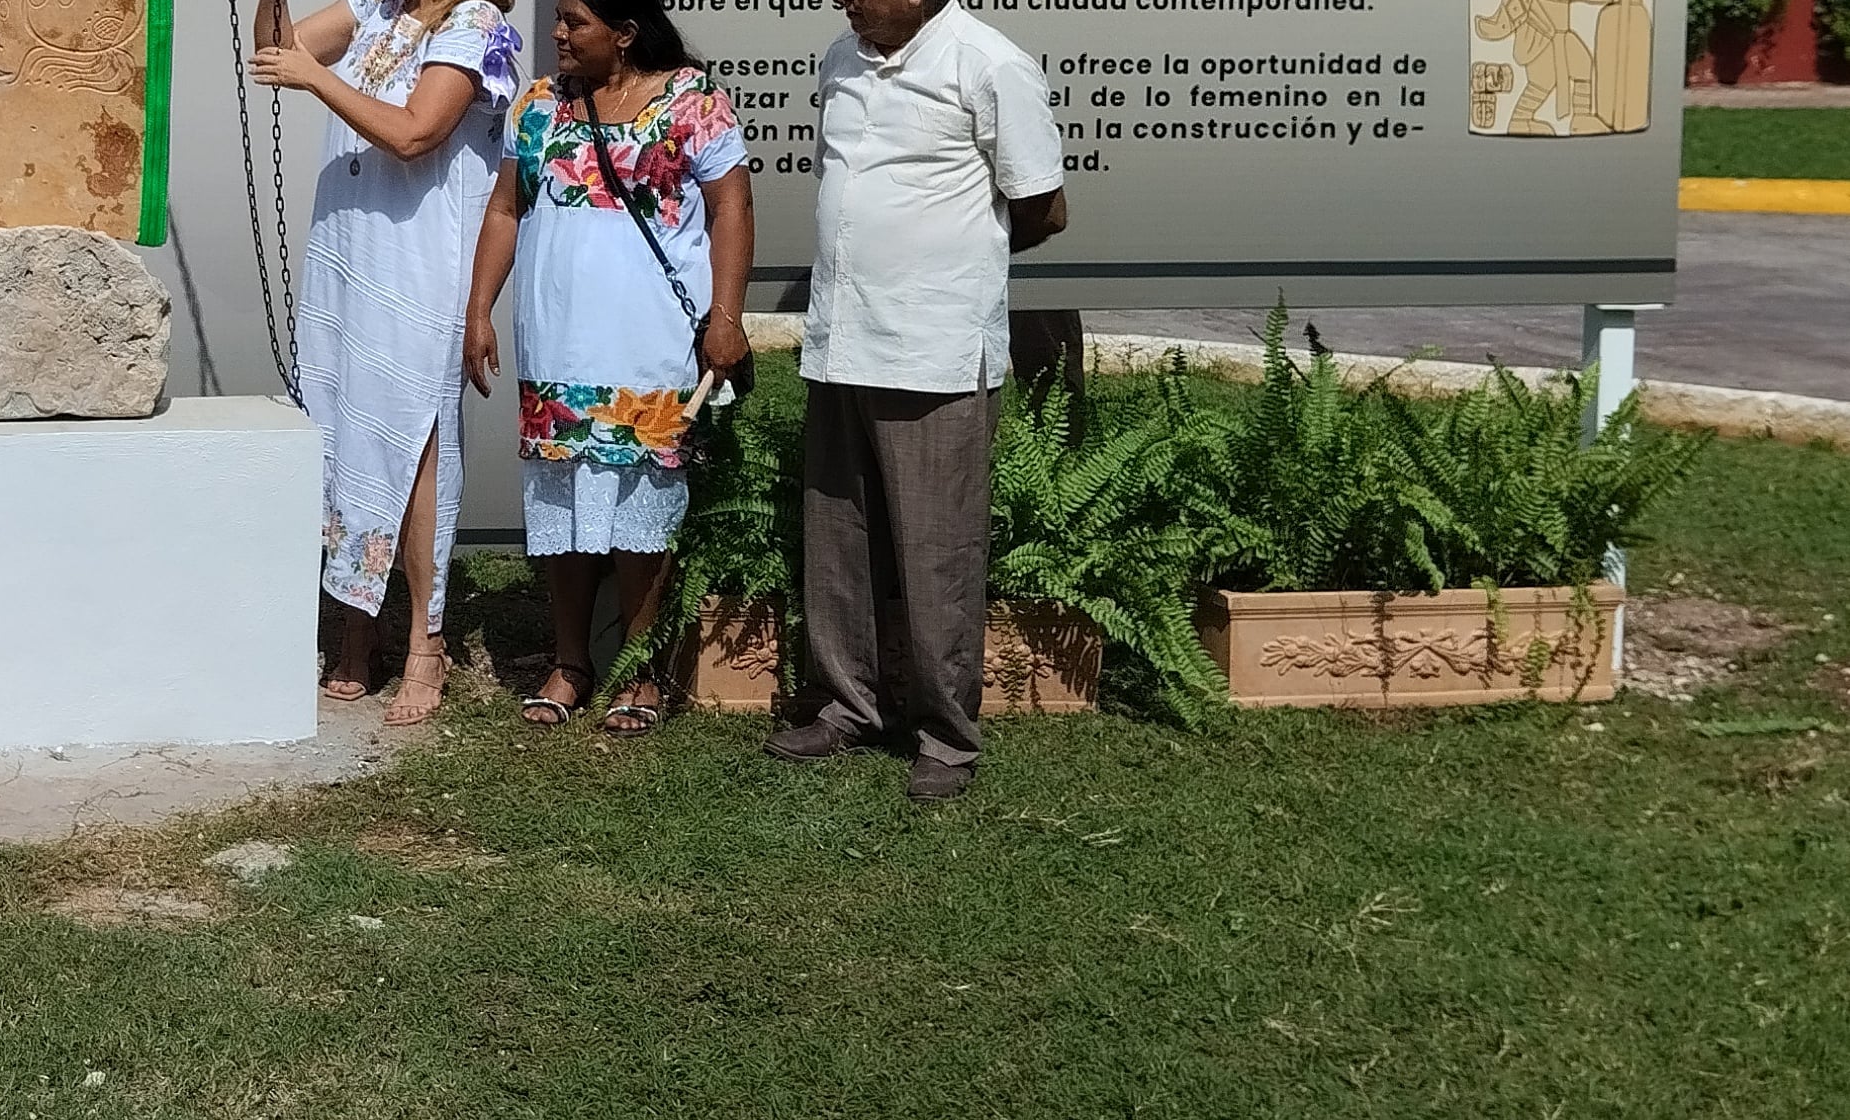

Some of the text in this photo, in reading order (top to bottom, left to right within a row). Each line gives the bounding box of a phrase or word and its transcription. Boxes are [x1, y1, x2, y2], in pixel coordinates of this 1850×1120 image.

[1059, 51, 1152, 75] ofrece
[1163, 53, 1189, 75] la
[1200, 51, 1382, 82] oportunidad
[1392, 53, 1427, 75] de
[1090, 85, 1126, 107] de
[1145, 85, 1171, 107] lo
[1189, 83, 1328, 107] femenino
[1346, 90, 1380, 107] en
[1400, 85, 1425, 107] la
[1095, 117, 1122, 140] la
[1132, 115, 1336, 139] construcción
[1346, 122, 1363, 146] y
